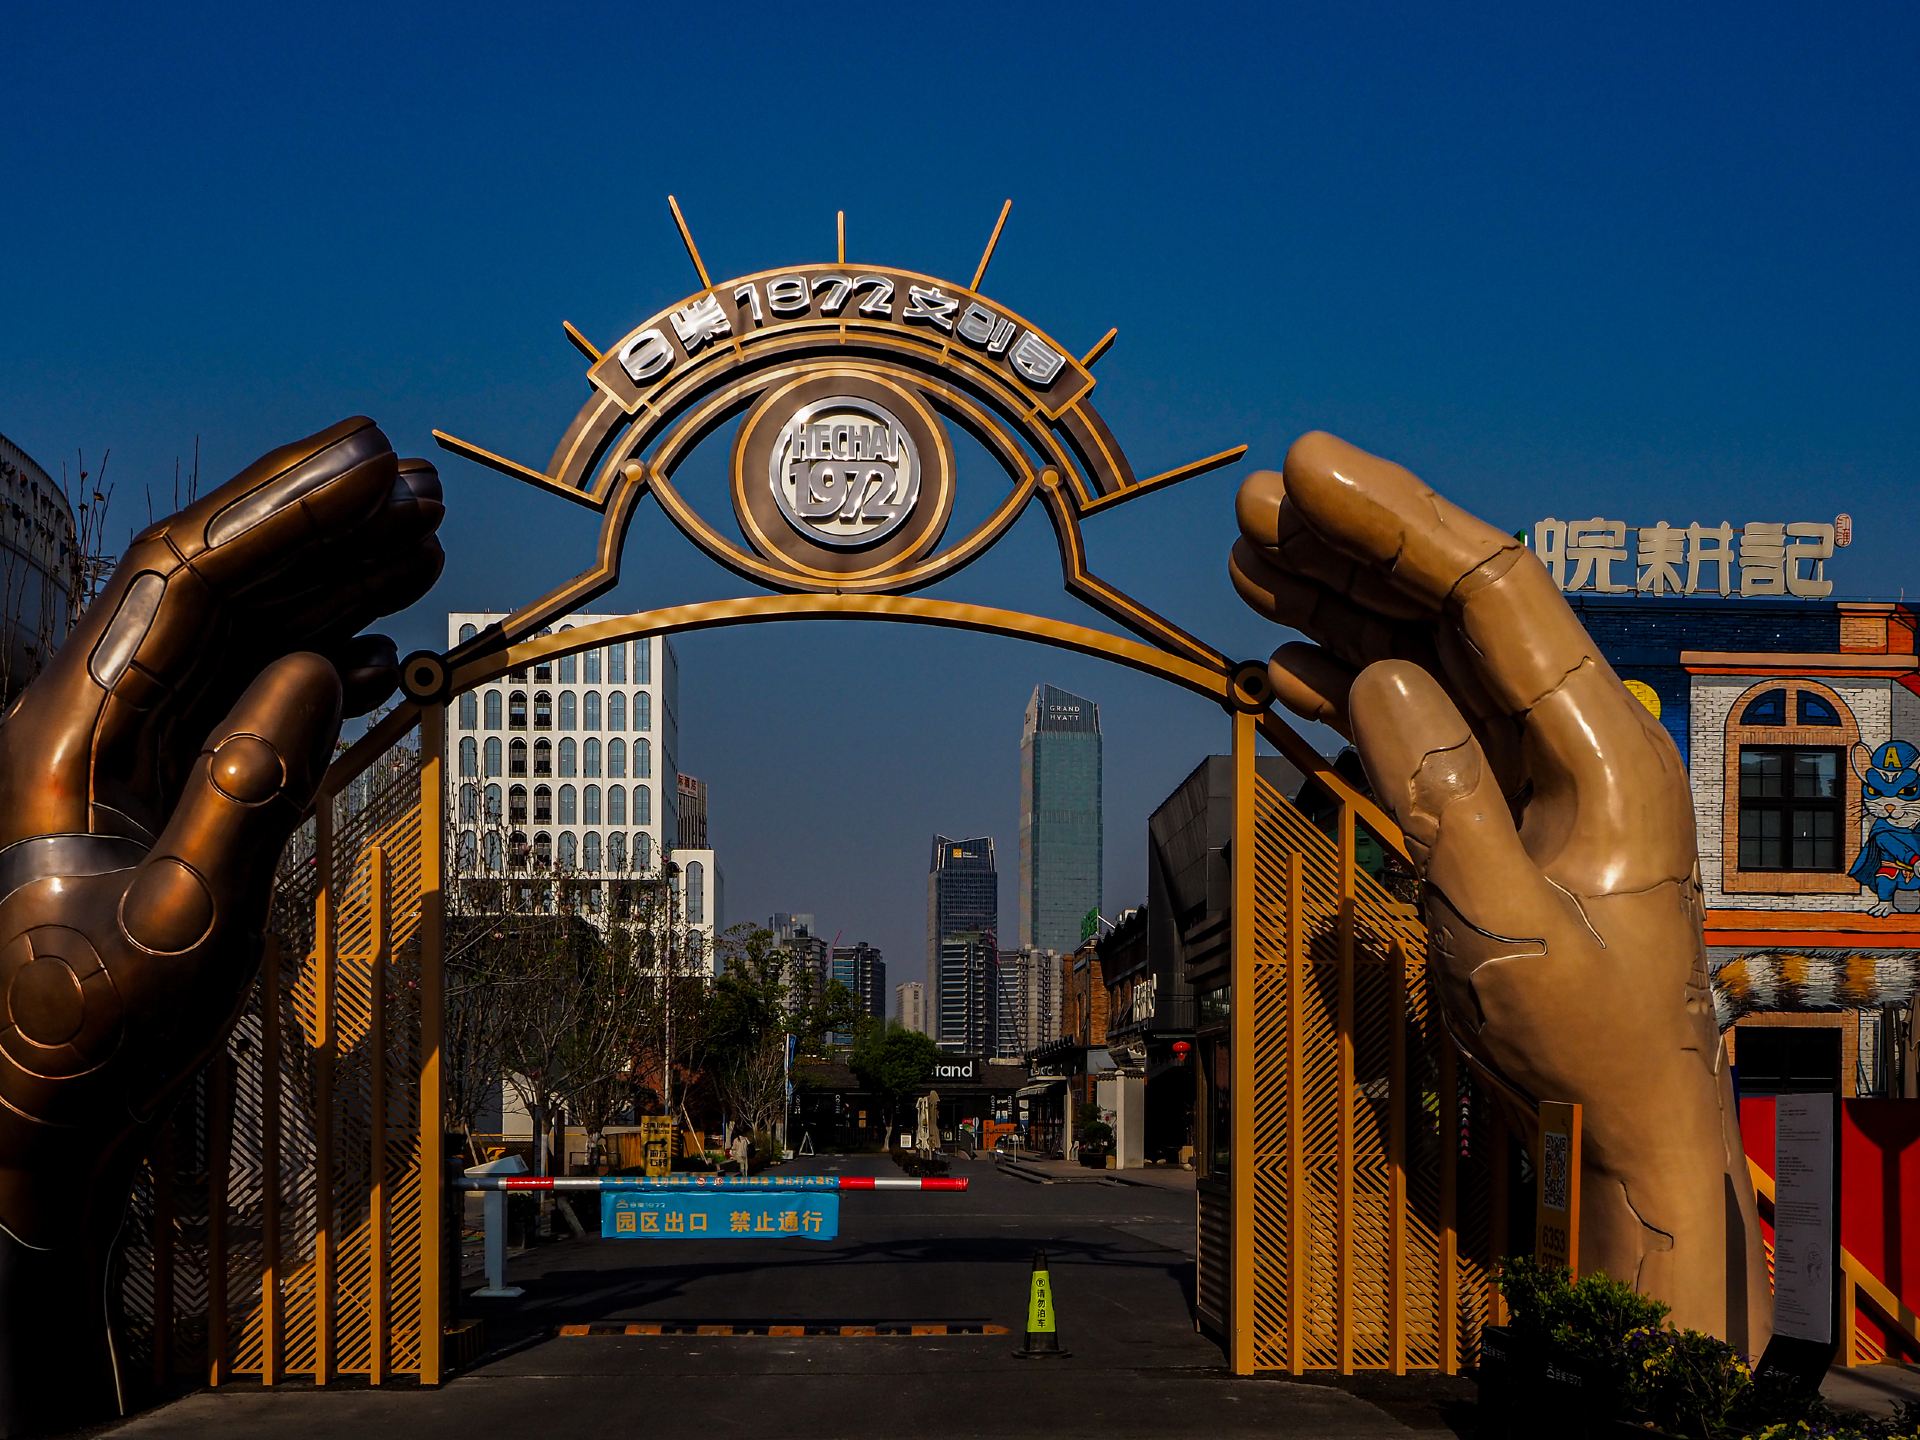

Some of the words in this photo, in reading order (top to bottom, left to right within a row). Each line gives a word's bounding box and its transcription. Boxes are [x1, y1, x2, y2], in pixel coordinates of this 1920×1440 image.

[791, 423, 898, 462] HECHAI
[789, 460, 896, 524] 1972
[1049, 705, 1080, 713] GRAND
[1883, 745, 1903, 769] A
[616, 1211, 708, 1233] 园区出口
[729, 1210, 824, 1233] 禁止通行
[1543, 1225, 1565, 1253] 6353
[1037, 1289, 1046, 1328] 请勿泊车
